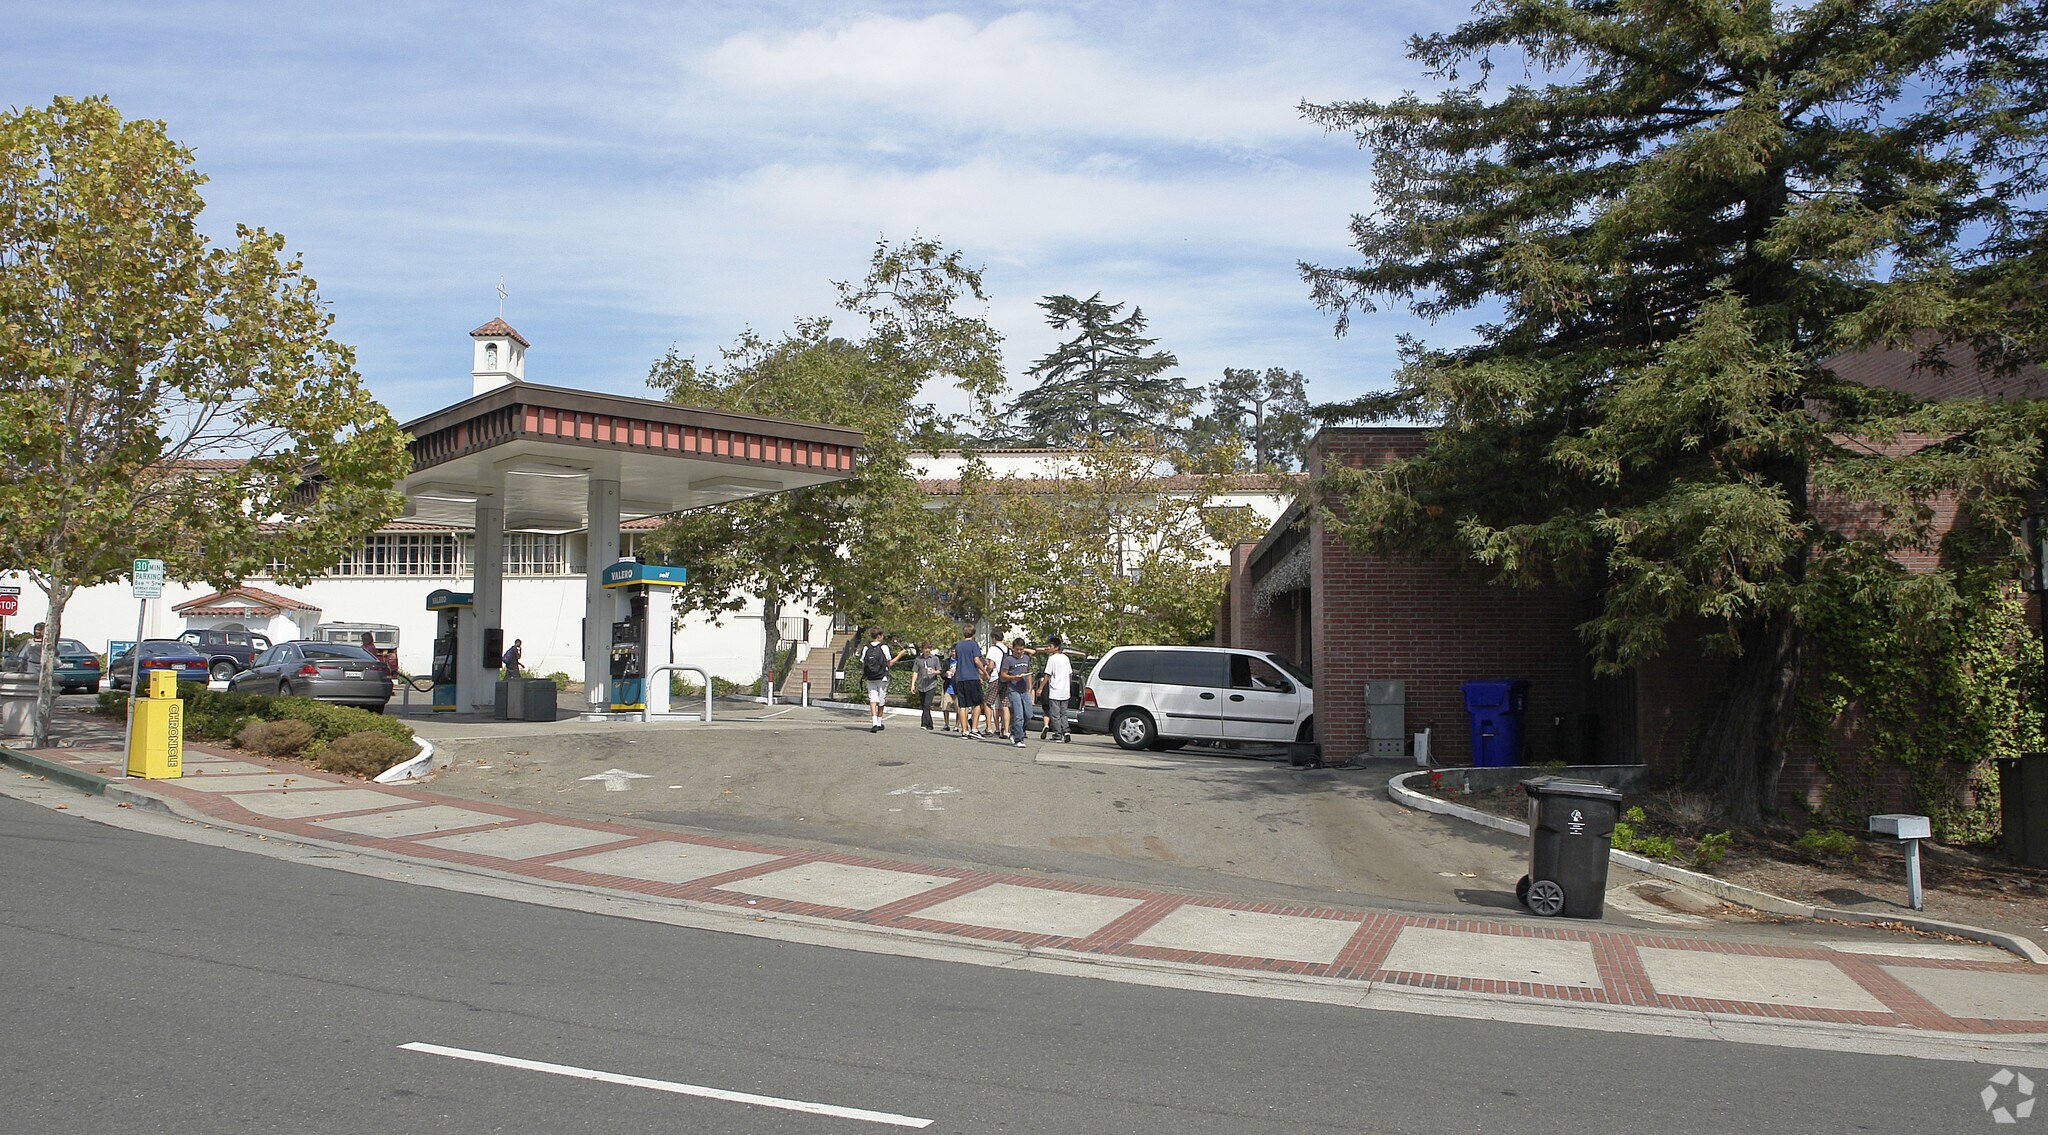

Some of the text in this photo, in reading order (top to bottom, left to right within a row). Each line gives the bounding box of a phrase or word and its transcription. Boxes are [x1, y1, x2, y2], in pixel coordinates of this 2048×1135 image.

[136, 561, 147, 571] 30
[611, 569, 633, 581] VALERO
[658, 571, 671, 579] self
[432, 596, 447, 604] VALERO
[168, 704, 179, 767] CHRONICLE
